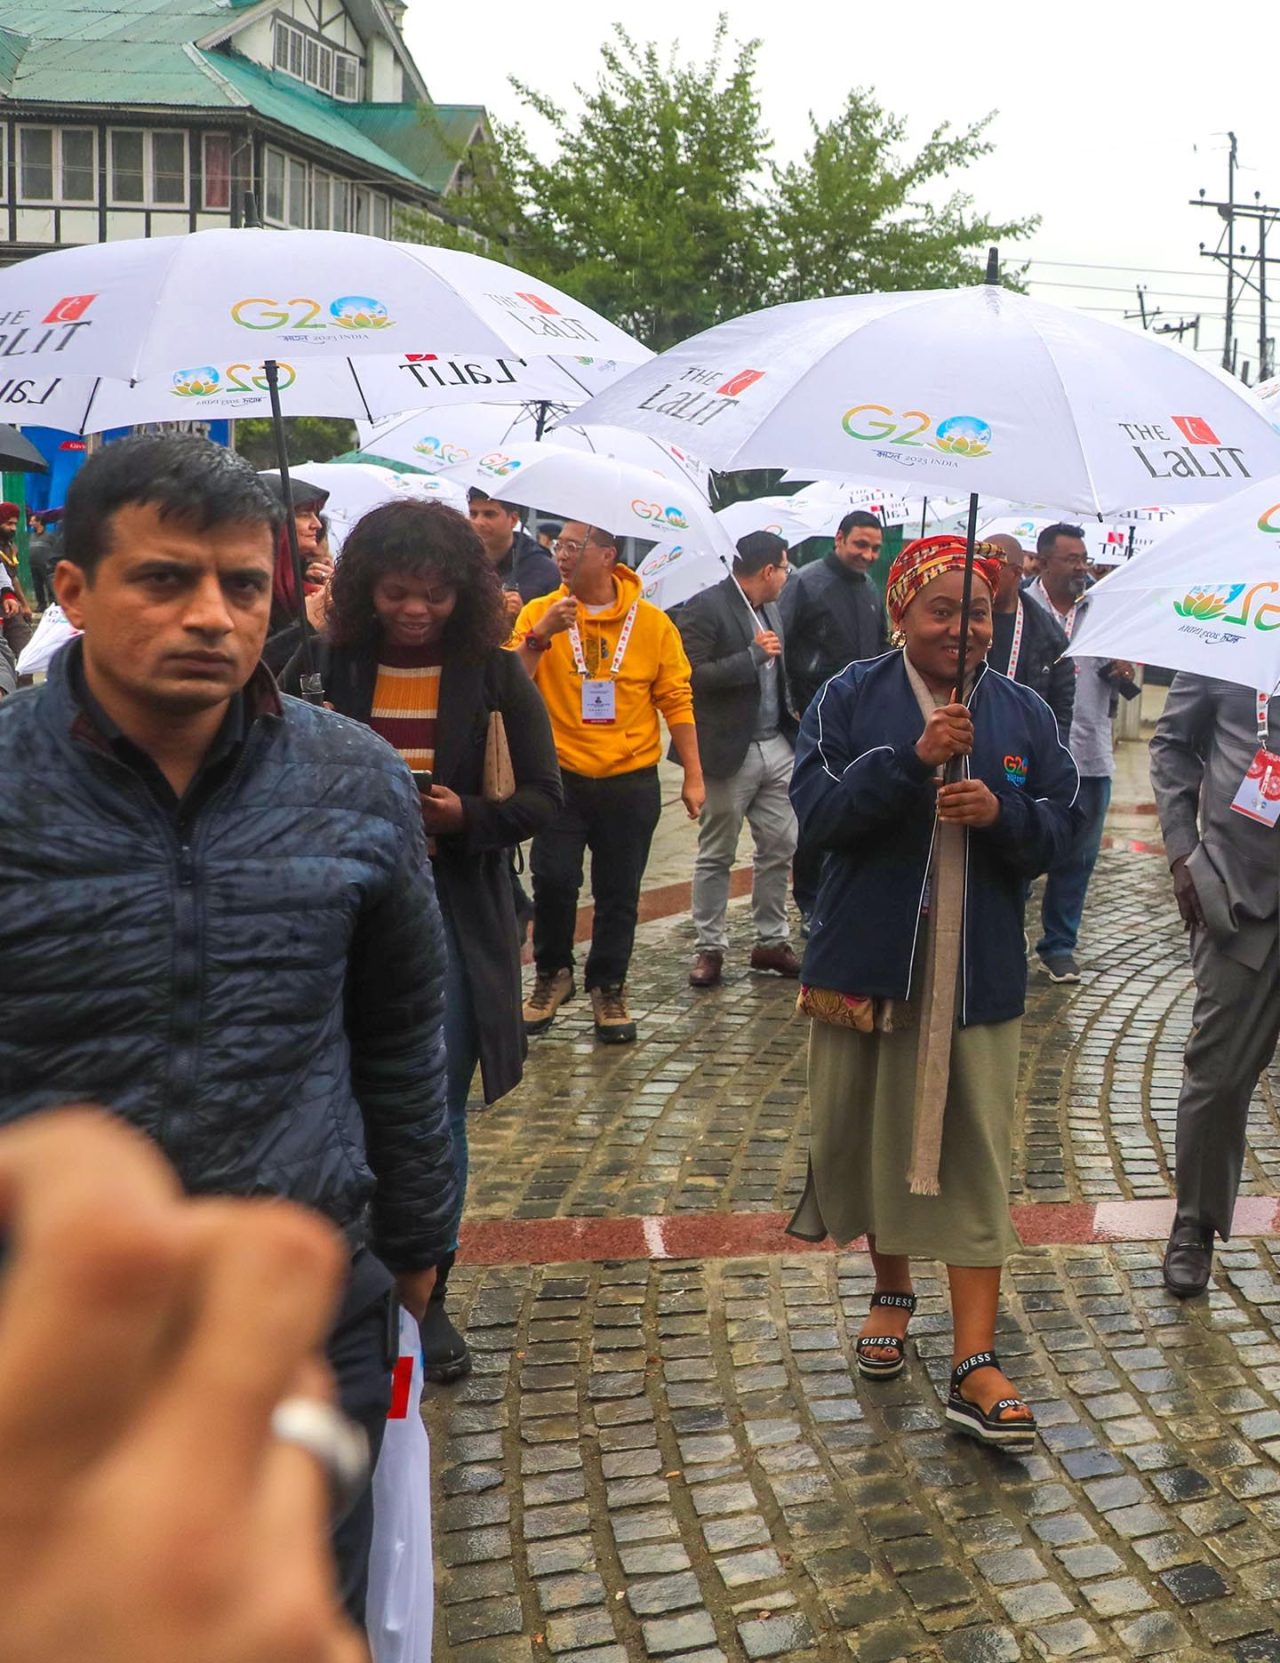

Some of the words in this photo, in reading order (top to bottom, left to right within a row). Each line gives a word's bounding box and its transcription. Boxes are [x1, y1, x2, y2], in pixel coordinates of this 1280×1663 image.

[679, 367, 724, 386] THE
[1118, 423, 1171, 441] THE
[880, 1295, 913, 1308] GUESS
[861, 1337, 898, 1346] GUESS
[956, 1352, 992, 1376] GUESS
